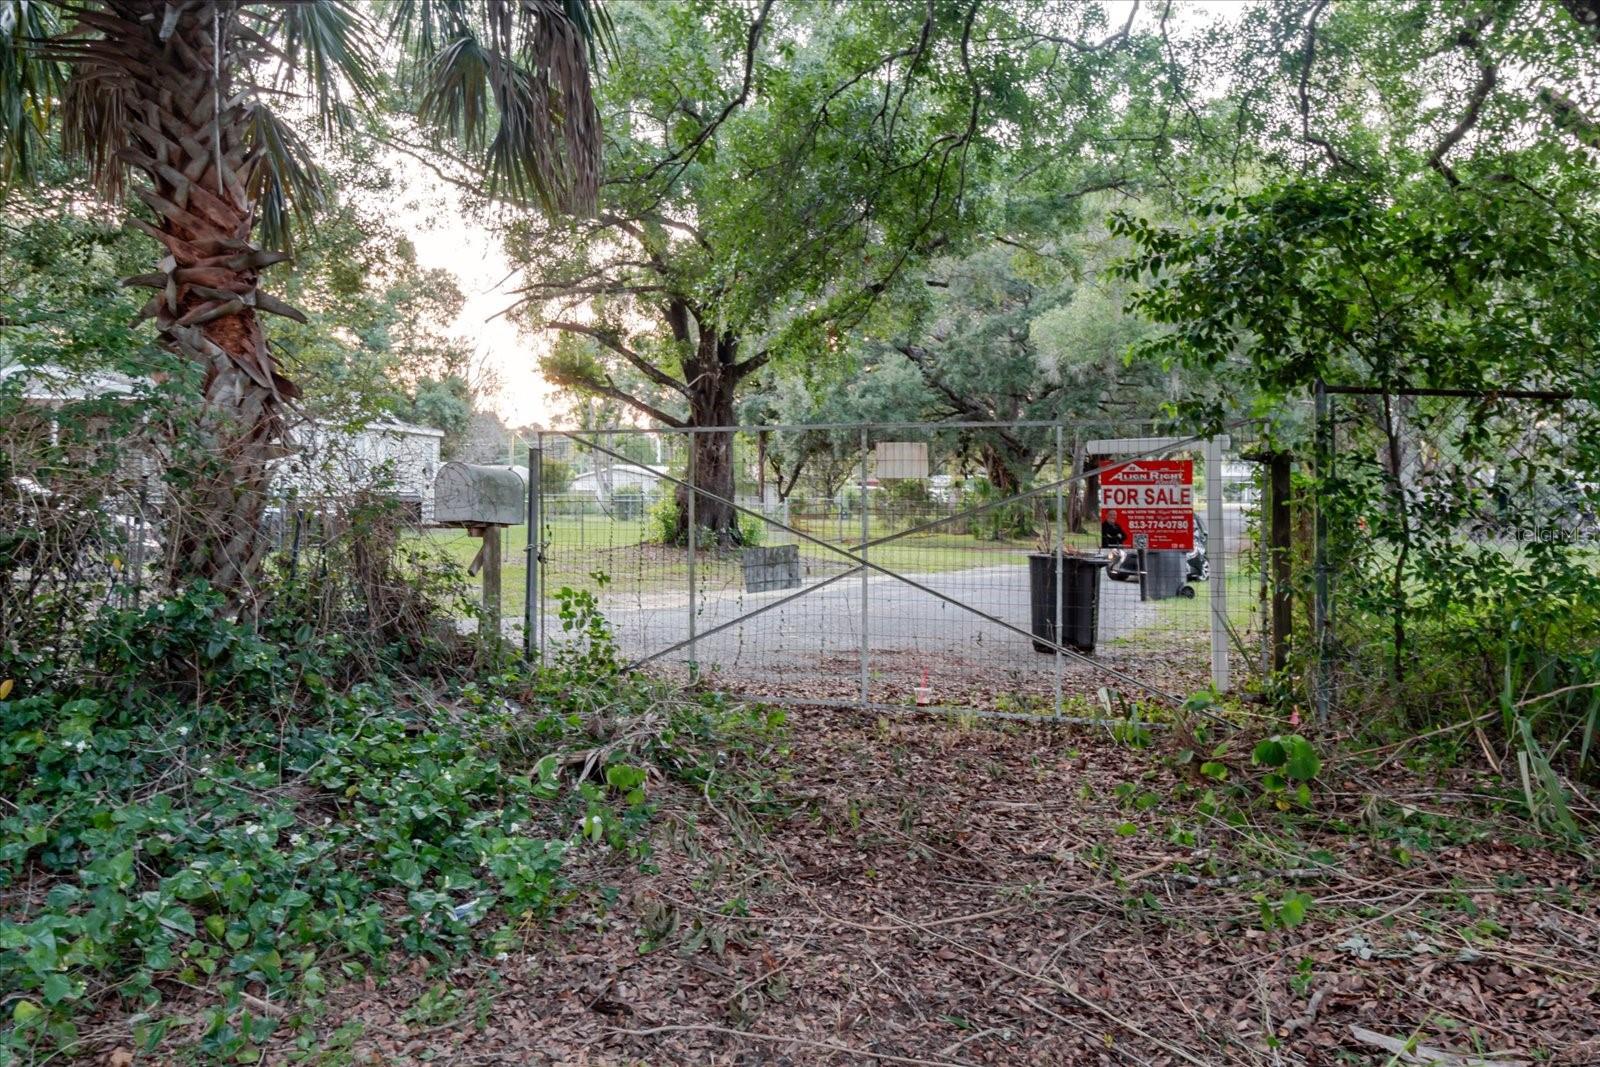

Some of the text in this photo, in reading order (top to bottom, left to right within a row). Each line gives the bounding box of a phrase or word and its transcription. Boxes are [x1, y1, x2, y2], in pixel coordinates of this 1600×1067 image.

[1109, 471, 1184, 481] ALIGN RIGHT
[1103, 488, 1191, 505] FOR SALE
[1128, 520, 1188, 529] 813-774-0780
